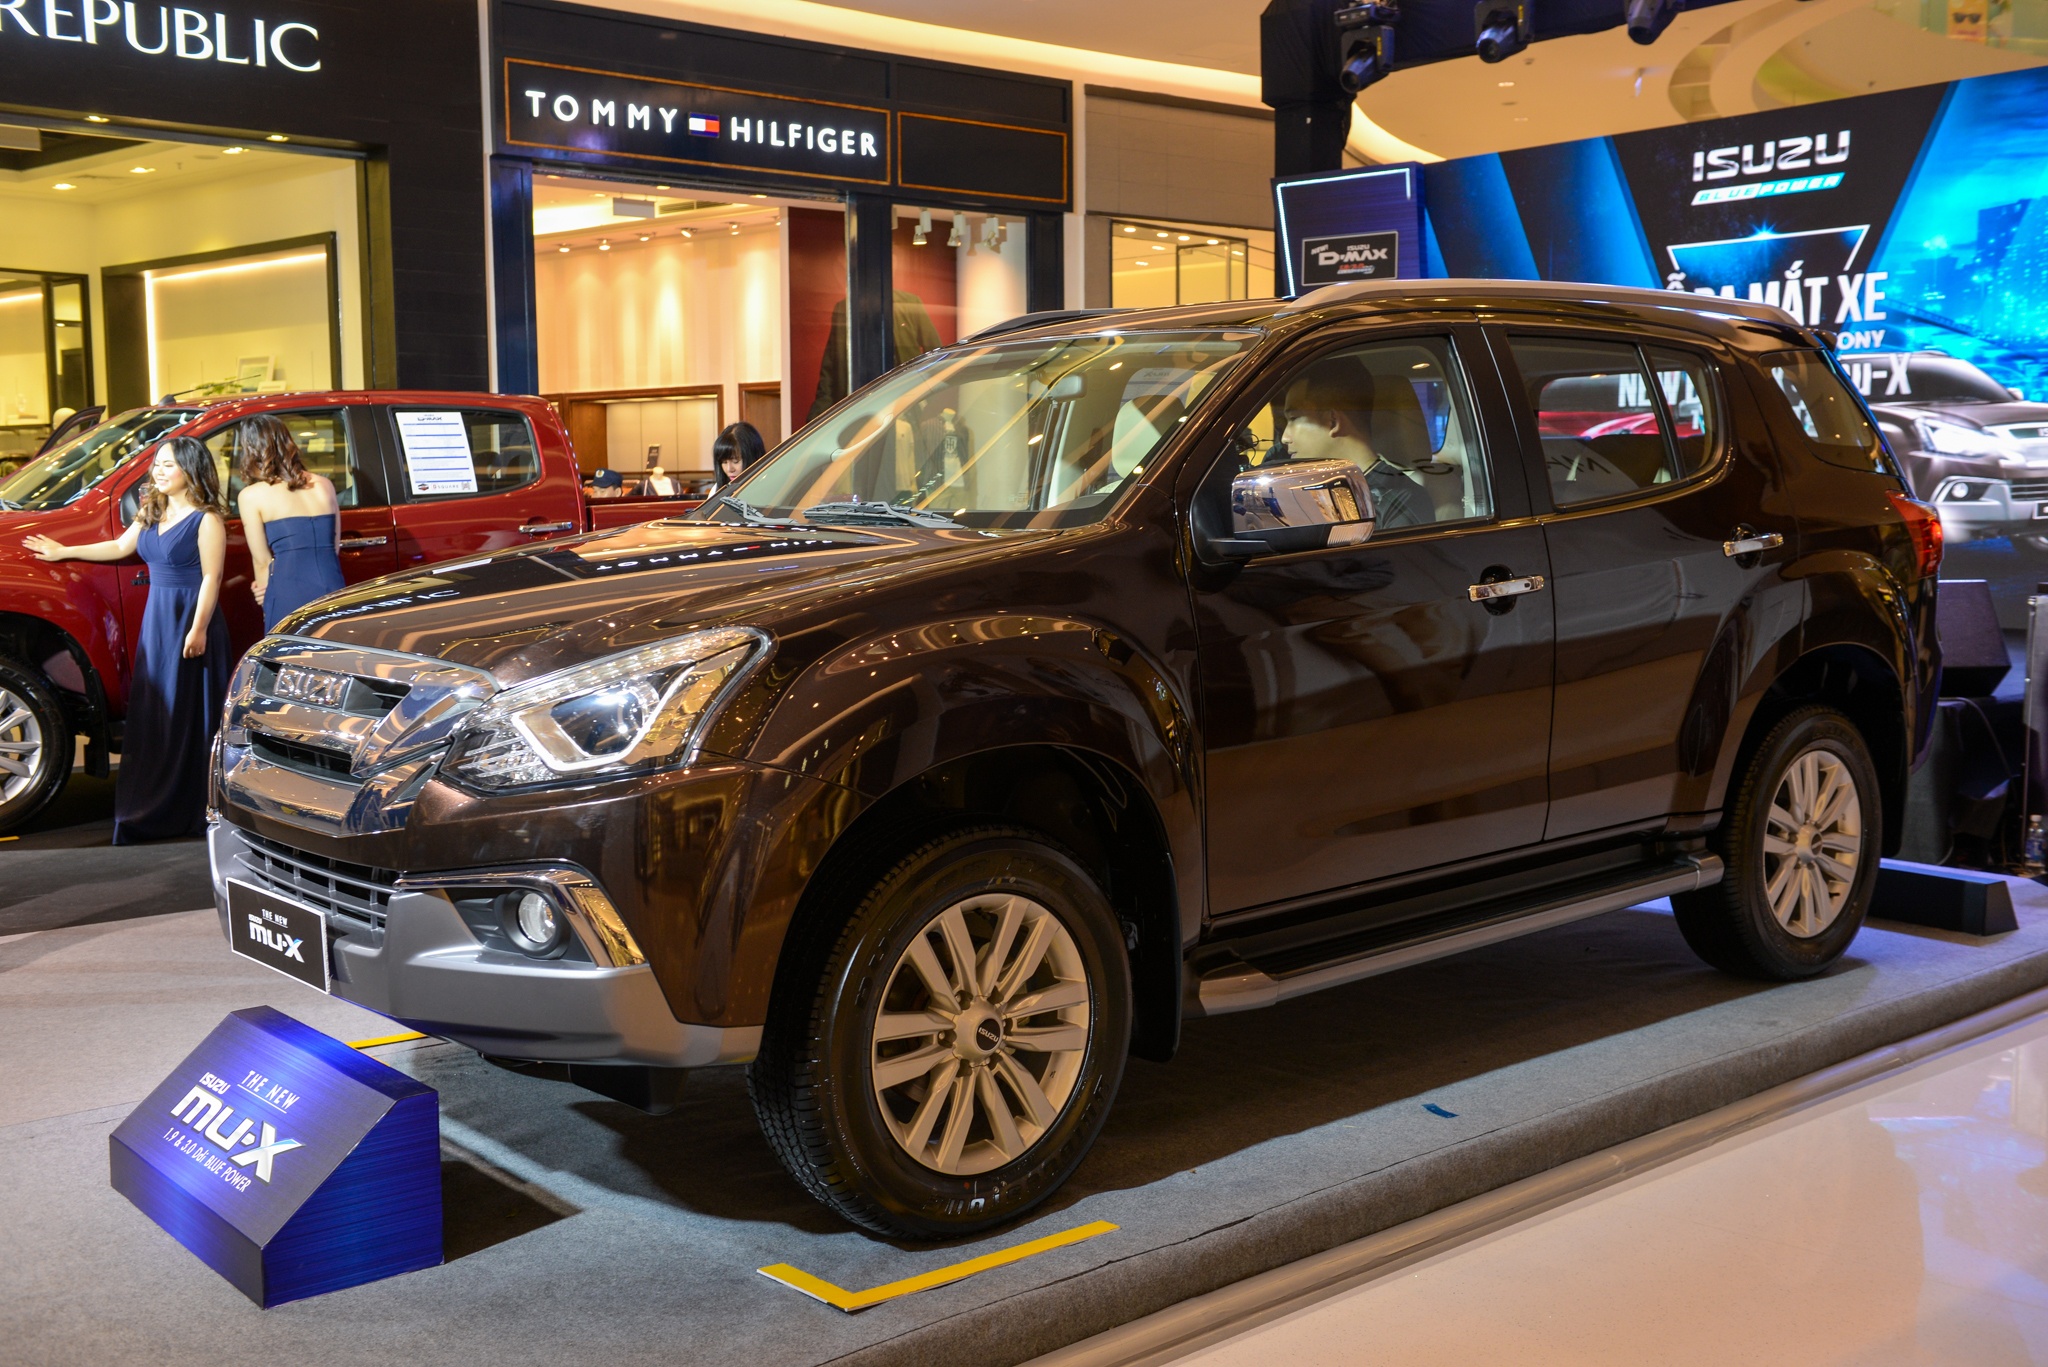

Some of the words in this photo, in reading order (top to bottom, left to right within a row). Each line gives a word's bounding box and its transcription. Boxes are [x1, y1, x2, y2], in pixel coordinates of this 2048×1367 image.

[525, 90, 678, 133] TOMMY
[731, 116, 877, 157] HILFIGER
[1692, 130, 1850, 182] ISUZU
[1318, 248, 1388, 266] D-MAX
[1835, 272, 1888, 324] XE
[273, 668, 350, 705] ISUZU
[262, 909, 273, 920] THE
[274, 913, 288, 926] NEW
[978, 1026, 999, 1042] ISUZU
[199, 1072, 231, 1095] ISUZU
[241, 1070, 269, 1093] THE
[265, 1083, 300, 1110] NEW
[163, 1127, 180, 1142] 1.9
[174, 1135, 187, 1147] &
[181, 1139, 196, 1155] 3.0
[204, 1153, 227, 1175] BLUE
[220, 1166, 252, 1193] POWER
